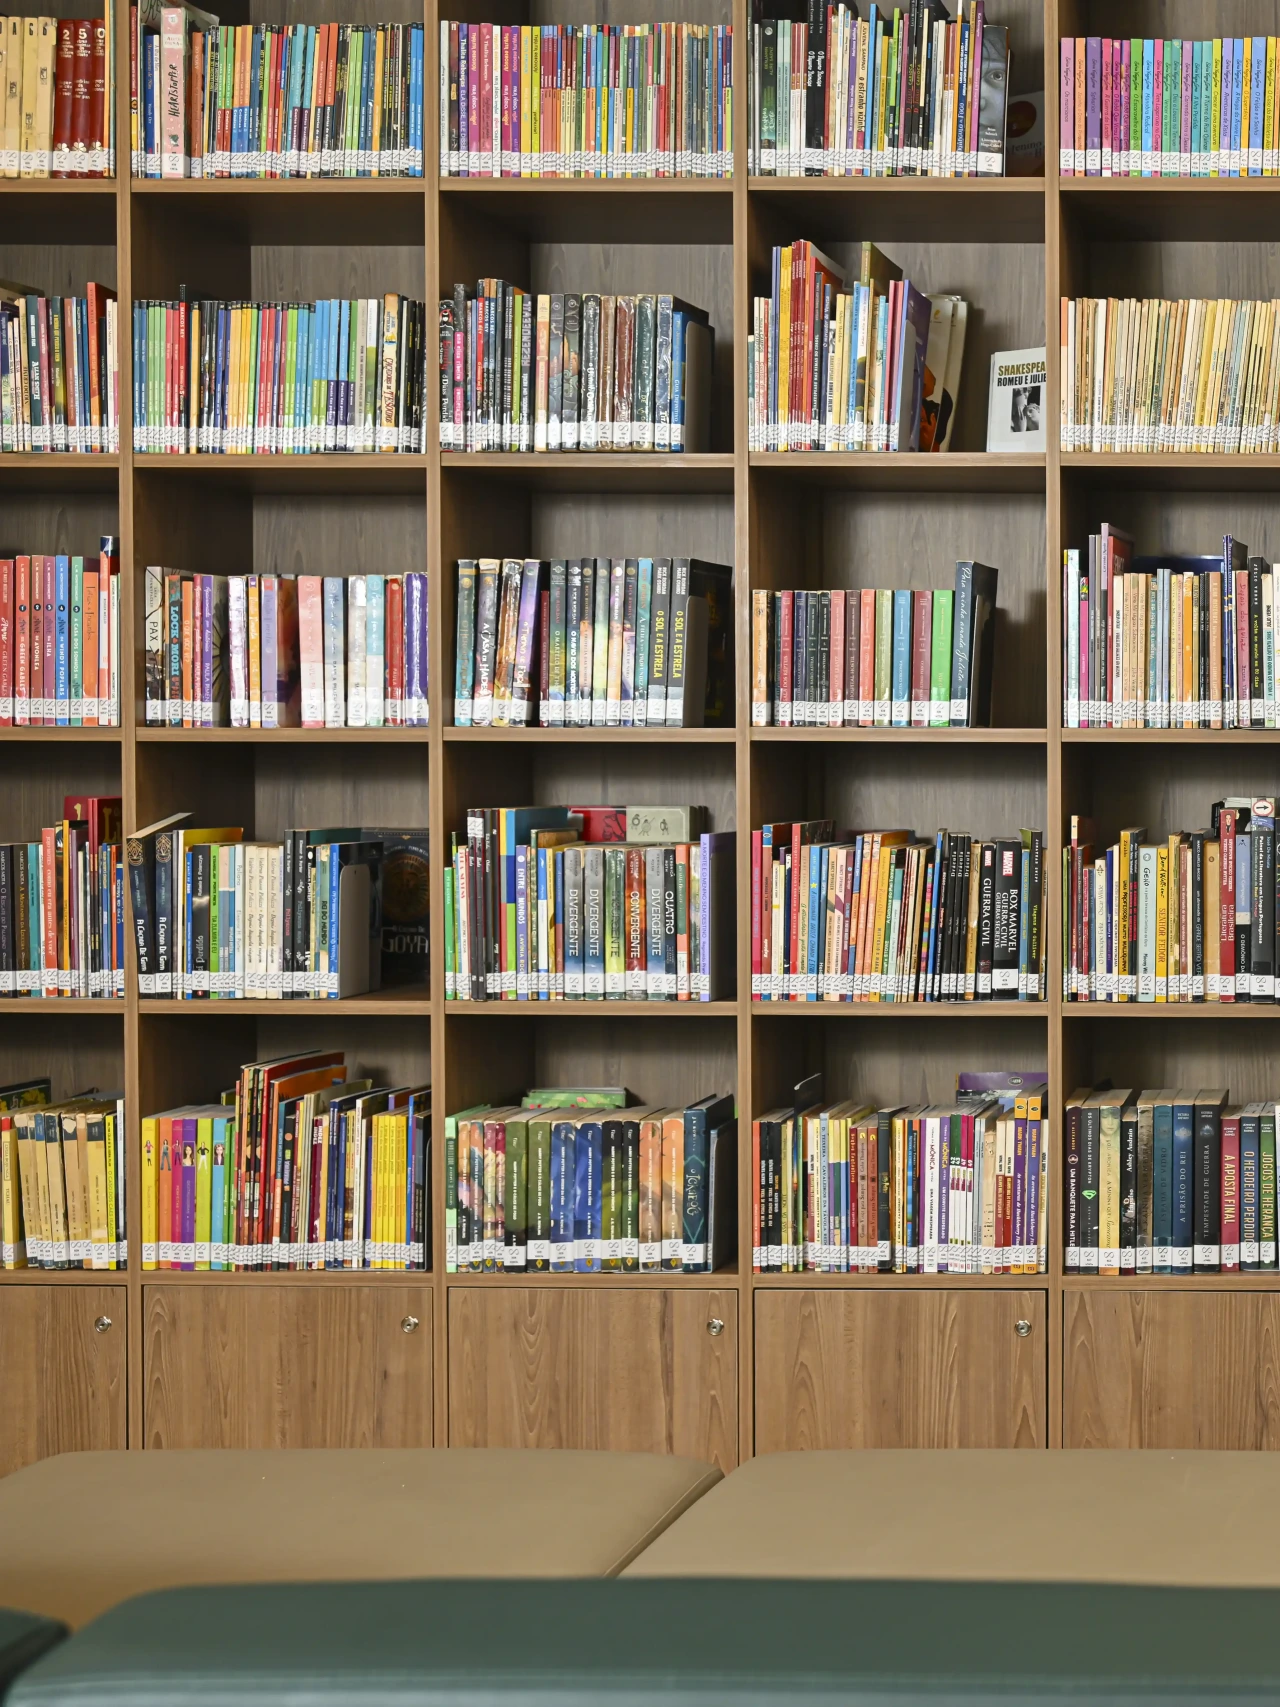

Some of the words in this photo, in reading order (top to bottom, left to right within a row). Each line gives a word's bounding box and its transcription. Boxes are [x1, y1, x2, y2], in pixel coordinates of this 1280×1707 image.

[998, 376, 1023, 387] ROMEU
[1025, 375, 1028, 384] E
[150, 622, 158, 641] PAX
[656, 617, 664, 631] SOL
[654, 645, 663, 678] ESTRELA
[1003, 851, 1013, 876] MARVEL
[665, 891, 674, 934] QUATRO
[983, 878, 991, 917] GUERRA
[1010, 889, 1018, 909] BOX
[569, 889, 578, 956] DIVERGENTE
[590, 889, 599, 956] DIVERGENTE
[631, 891, 640, 958] CONVERGENTE
[652, 889, 661, 956] DIVERGENTE
[982, 920, 990, 946] CIVIL
[1008, 913, 1017, 952] MARVEL
[1180, 1168, 1186, 1180] DO
[1224, 1164, 1234, 1196] APOSTA
[1262, 1152, 1272, 1180] JOGOS
[1204, 1178, 1209, 1186] DE
[1244, 1160, 1254, 1204] HERDEIRO
[1262, 1183, 1272, 1194] DE
[1224, 1199, 1234, 1224] FINAL
[1261, 1197, 1273, 1238] HERANÇA
